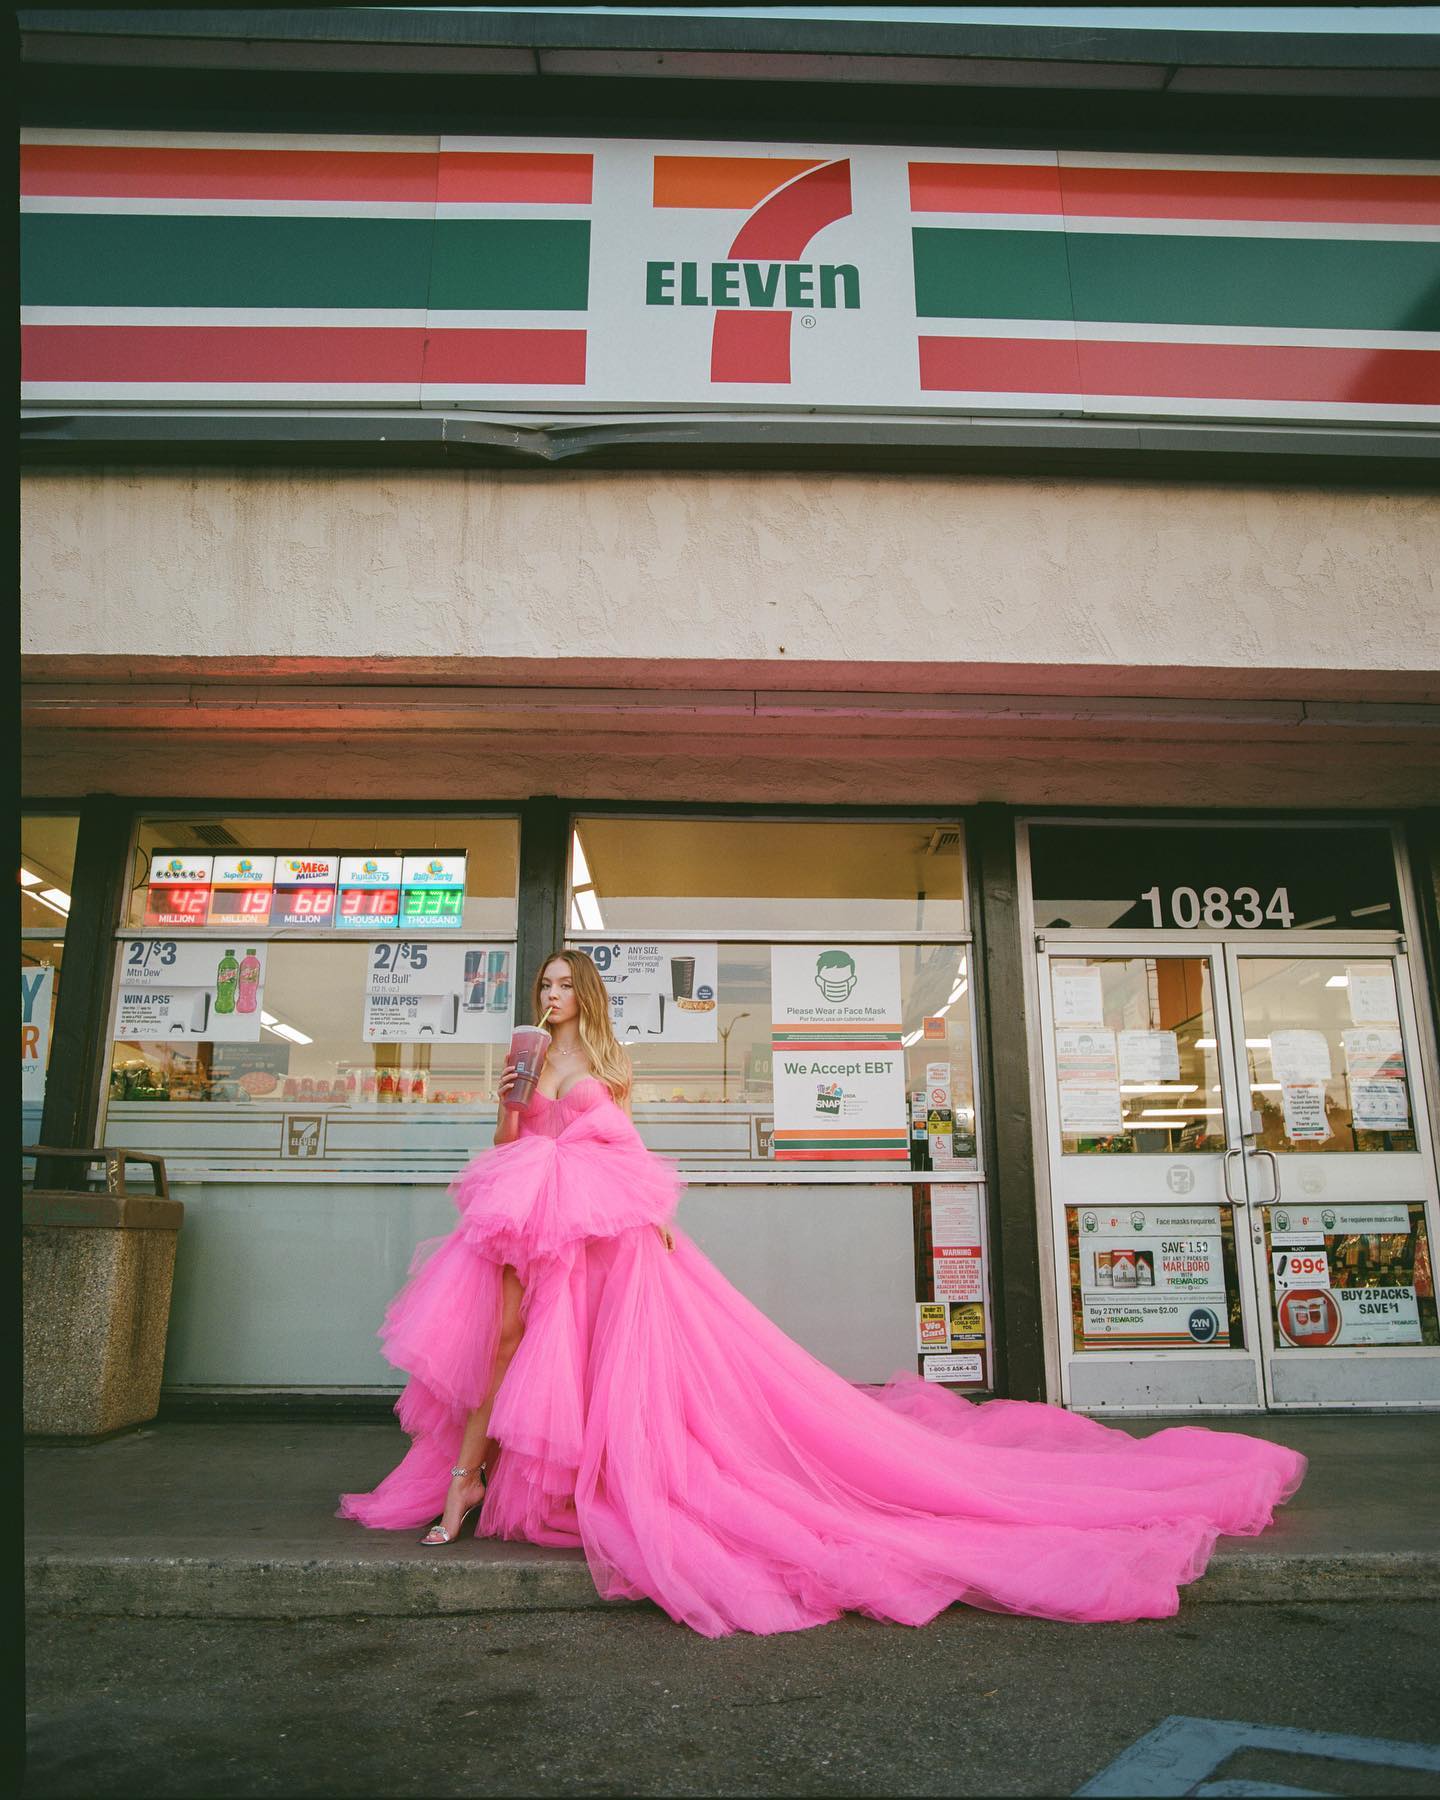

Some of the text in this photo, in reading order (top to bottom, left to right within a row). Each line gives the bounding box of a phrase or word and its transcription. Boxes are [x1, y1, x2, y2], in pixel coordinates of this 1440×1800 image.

[653, 155, 852, 384] 7
[646, 261, 860, 309] ELEVEn
[300, 861, 330, 873] MEGA
[171, 889, 208, 913] 42
[242, 889, 270, 913] 19
[293, 889, 330, 914] 68
[407, 891, 462, 914] 334
[1141, 886, 1294, 928] 10834
[159, 914, 195, 923] MILLION
[222, 914, 258, 923] MILLION
[284, 914, 321, 923] MILLION
[344, 916, 393, 924] THOUSAND
[408, 916, 457, 924] THOUSAND
[374, 942, 428, 972] 2/$5
[127, 969, 160, 977] Mtn Dew
[373, 974, 409, 984] Red Bull
[124, 994, 170, 1004] WIN A PS5
[372, 996, 418, 1005] WIN A PS5
[608, 996, 624, 1005] S5
[784, 1062, 893, 1077] We Accept EBT
[816, 1100, 840, 1108] SNAP
[1190, 1218, 1216, 1226] required.
[1348, 1216, 1374, 1224] requieren
[942, 1248, 972, 1256] WARNING
[1162, 1242, 1184, 1253] SAVE
[1163, 1261, 1210, 1272] MARLBORO
[1290, 1258, 1325, 1274] 99¢
[1341, 1289, 1414, 1301] BUY 2 PACKS,
[1359, 1302, 1399, 1314] SAVE $1
[925, 1322, 940, 1330] We
[1191, 1319, 1210, 1328] ZYN
